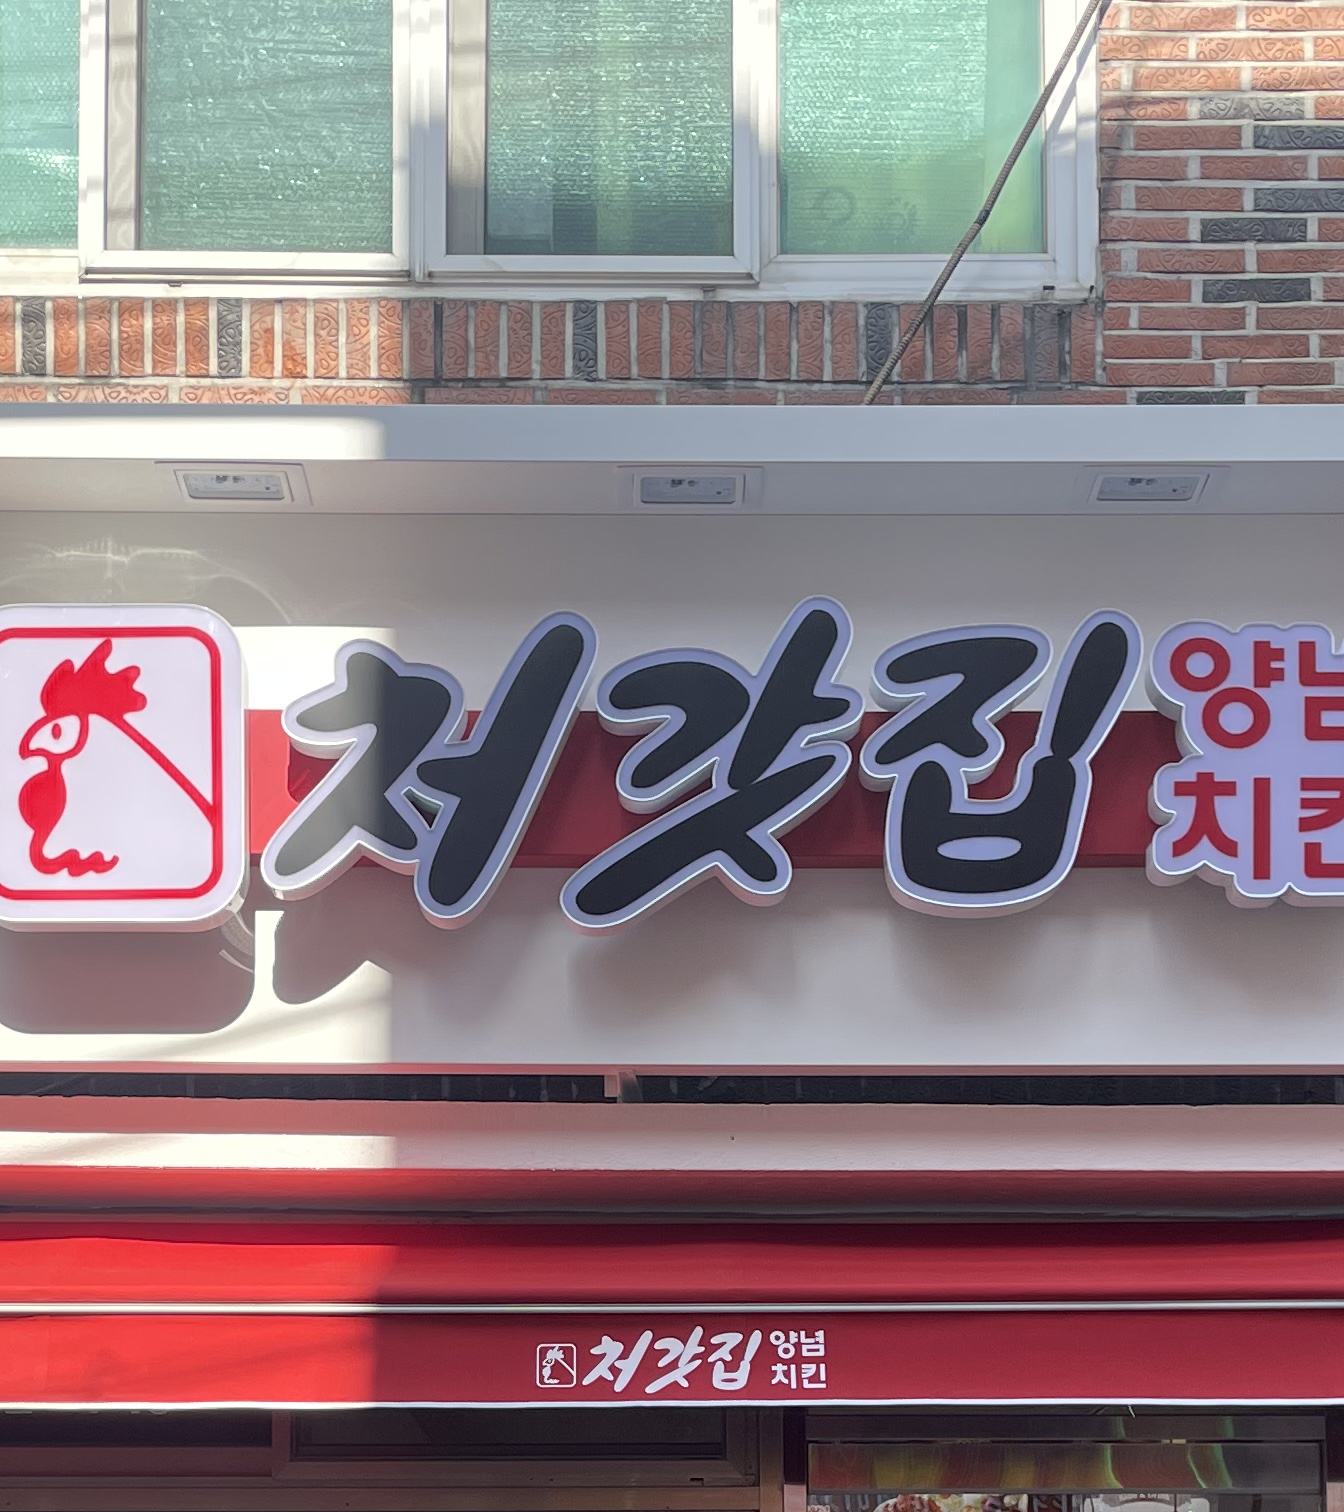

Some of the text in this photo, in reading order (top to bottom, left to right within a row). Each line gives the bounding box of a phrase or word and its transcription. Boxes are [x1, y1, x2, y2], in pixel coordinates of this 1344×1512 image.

[268, 602, 1136, 921] 처갓집
[582, 1326, 762, 1394] 처갓집
[769, 1330, 825, 1359] 양념
[771, 1362, 827, 1389] 치킨
